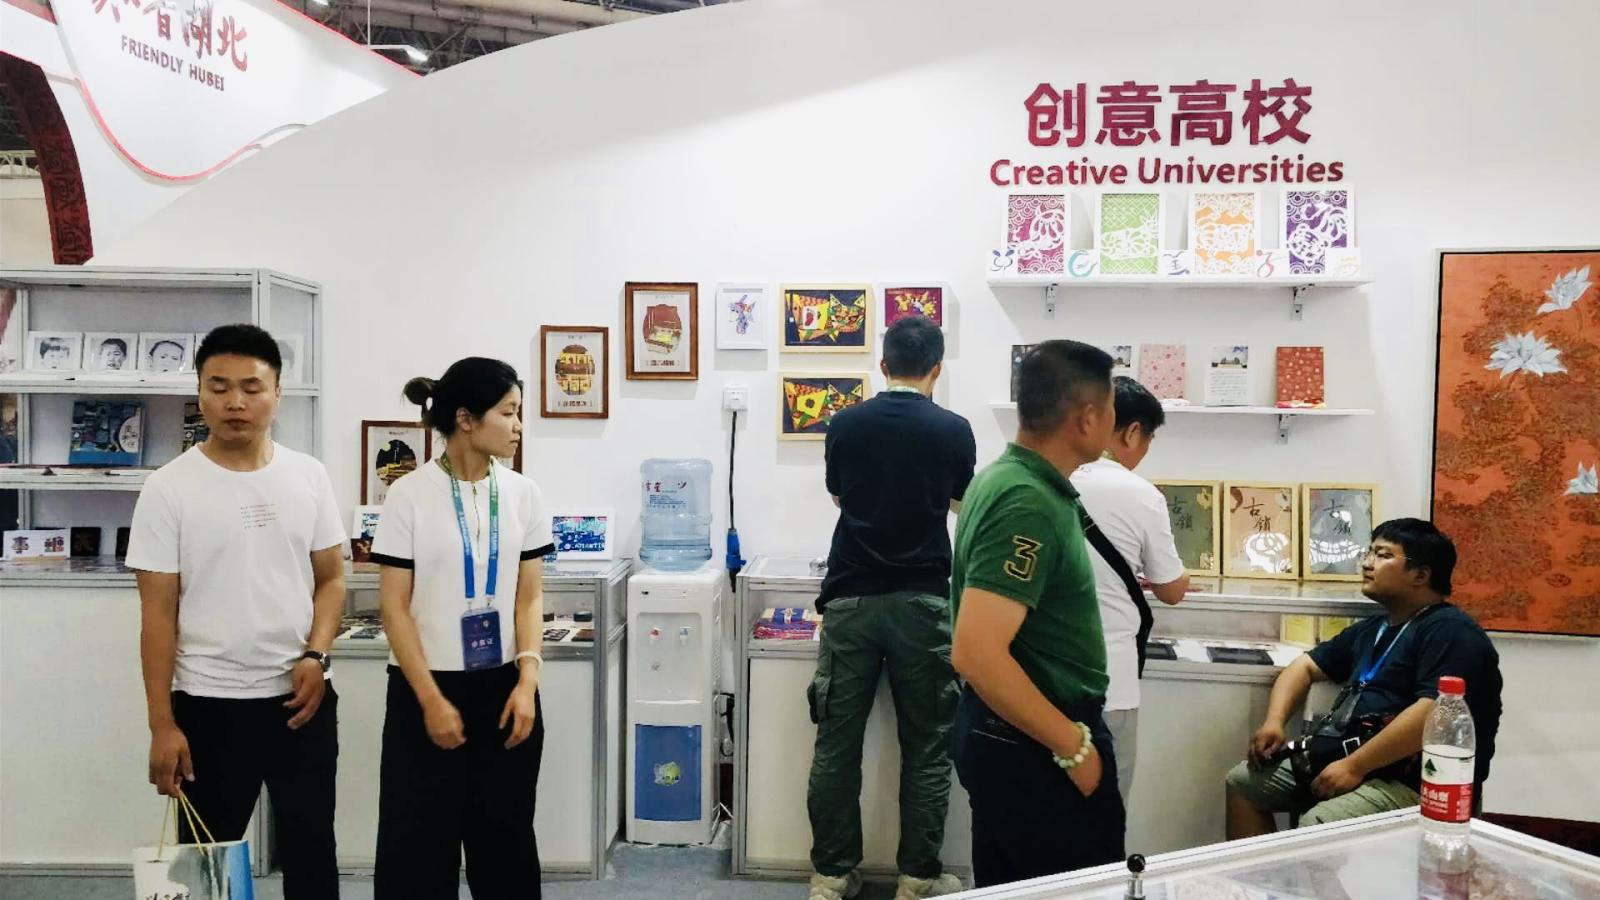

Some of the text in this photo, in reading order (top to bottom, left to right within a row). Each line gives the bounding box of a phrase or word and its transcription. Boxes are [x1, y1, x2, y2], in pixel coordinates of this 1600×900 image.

[121, 35, 224, 91] FRIENDLY HUBEI
[1024, 78, 1313, 148] 创意高校
[990, 154, 1345, 186] Creative Universities
[1003, 535, 1044, 582] 3
